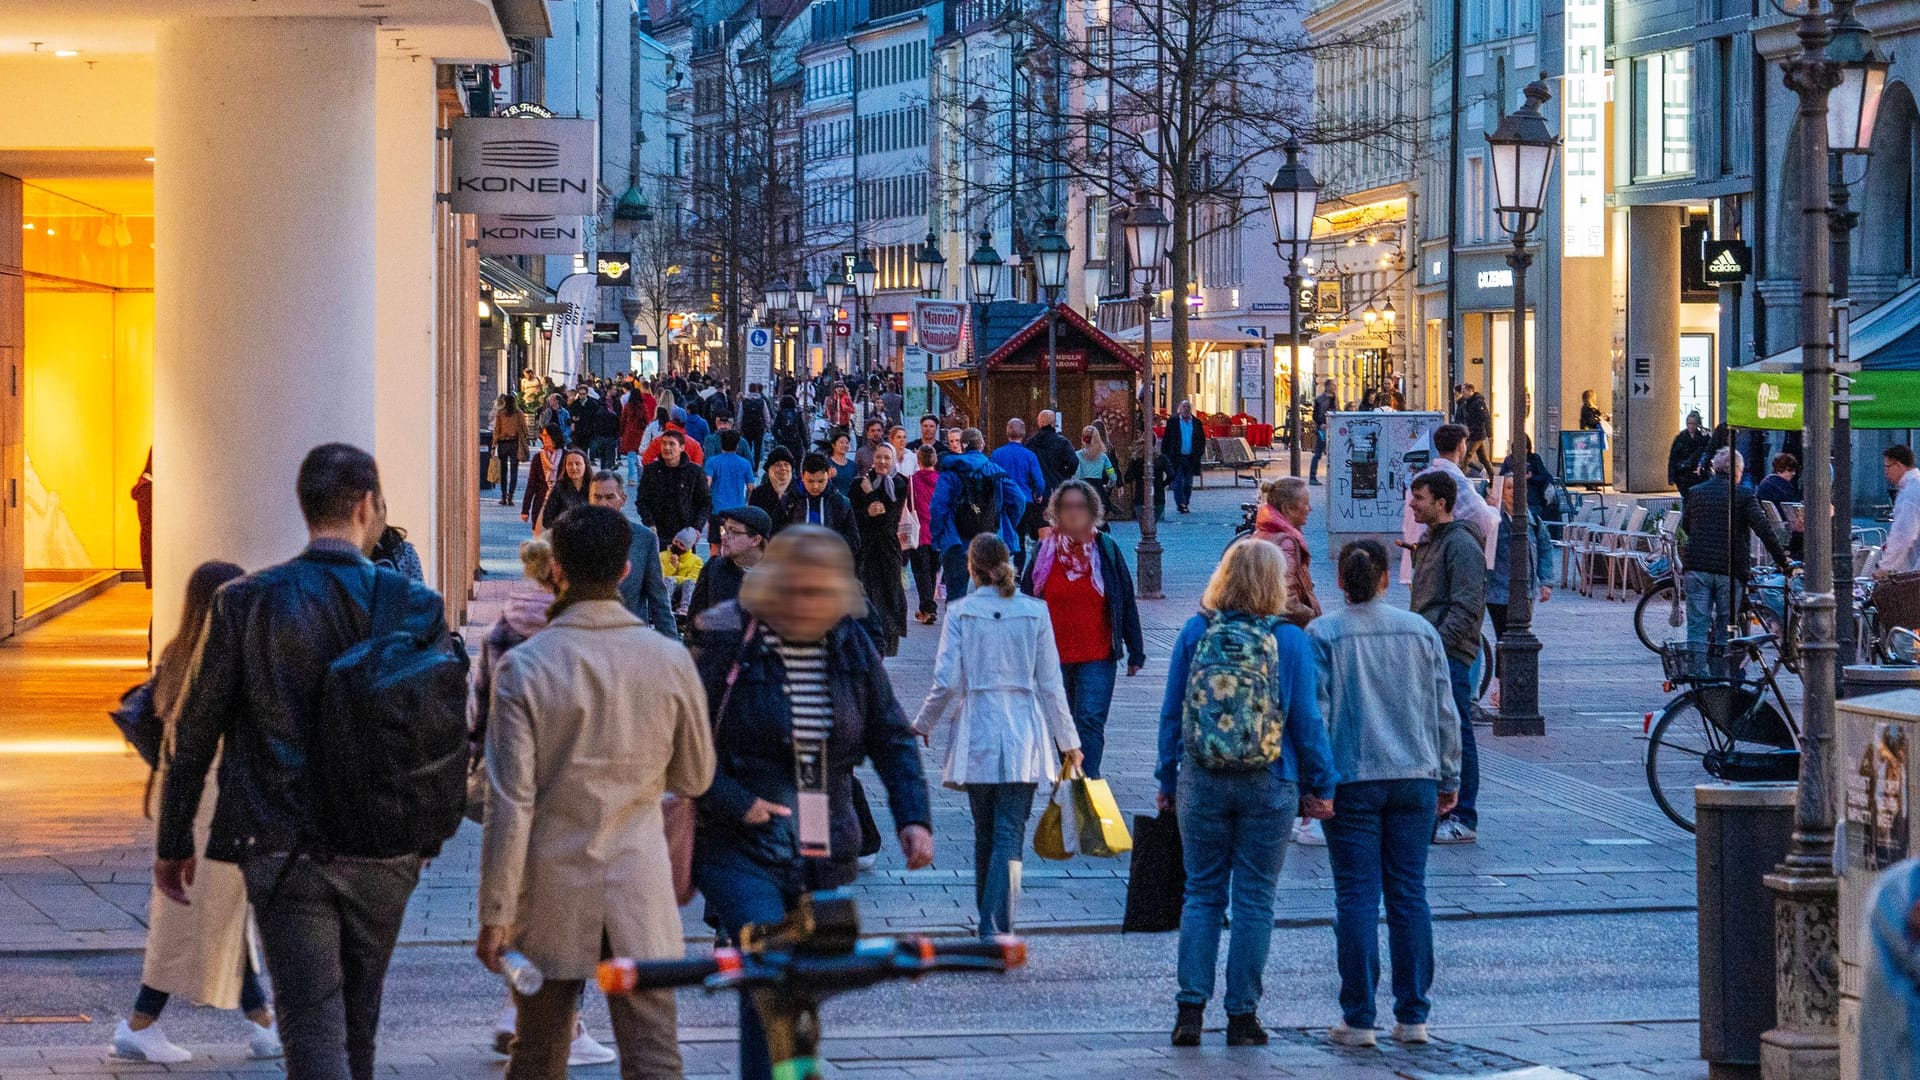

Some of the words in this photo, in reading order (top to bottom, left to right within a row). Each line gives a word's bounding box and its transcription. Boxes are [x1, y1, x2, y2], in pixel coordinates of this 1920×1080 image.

[1568, 0, 1597, 176] HOFST
[458, 177, 586, 193] KONEN
[482, 227, 576, 240] KONEN
[1709, 264, 1742, 273] adidas
[563, 302, 573, 326] YOUR
[572, 303, 581, 326] CITY
[923, 311, 958, 326] Maroni
